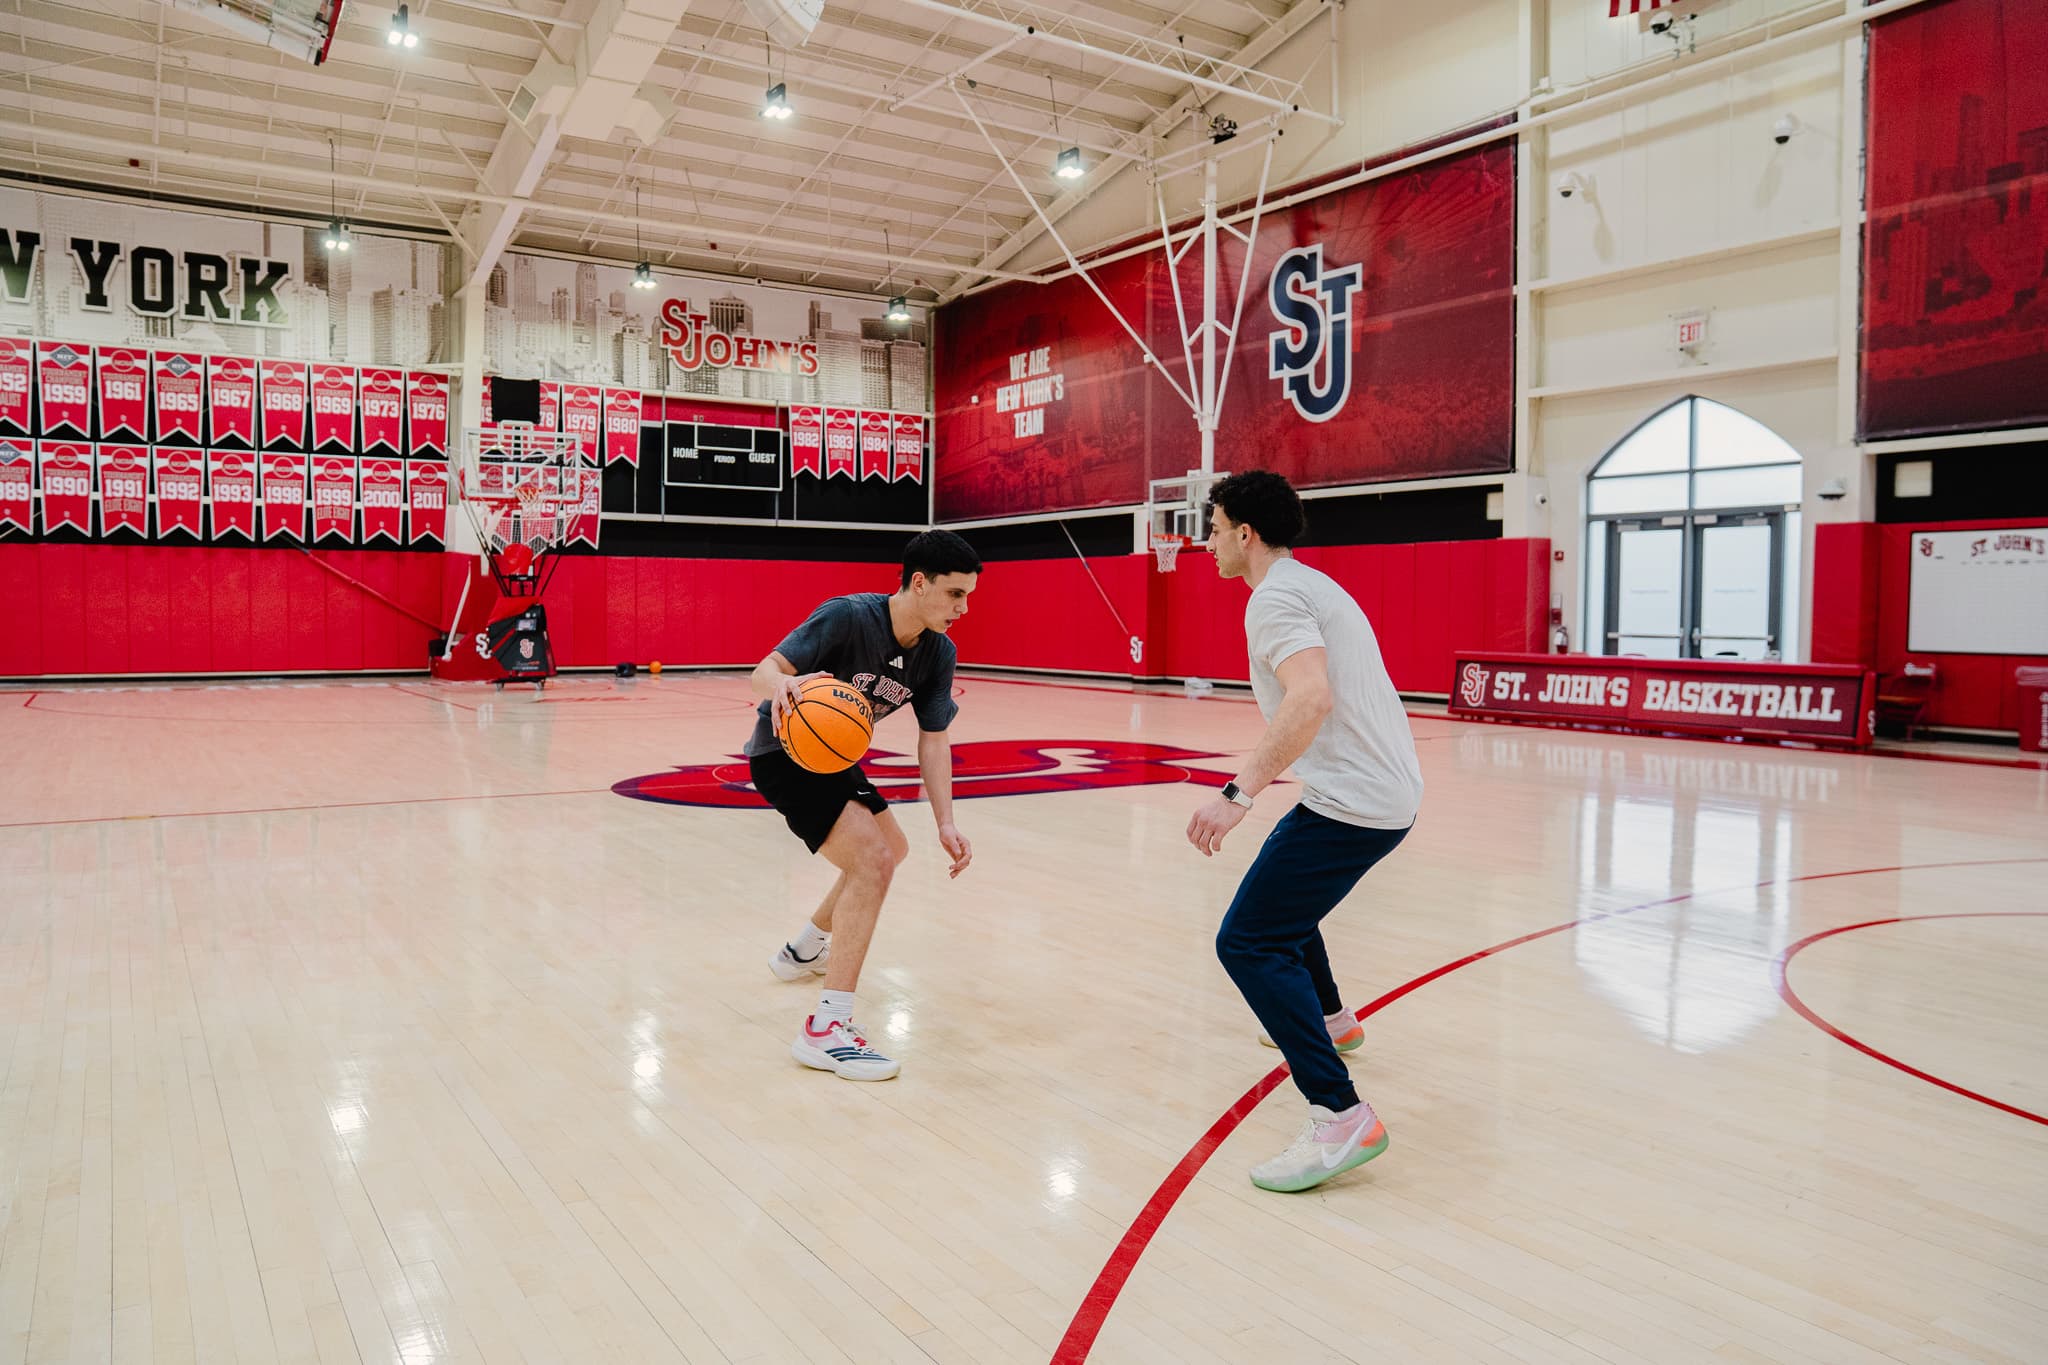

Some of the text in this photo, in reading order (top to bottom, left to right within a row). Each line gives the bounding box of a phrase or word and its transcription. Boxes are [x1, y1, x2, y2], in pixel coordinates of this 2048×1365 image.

[71, 237, 289, 324] YORK
[1010, 346, 1050, 380] WE ARE
[0, 373, 26, 392] 52
[105, 381, 142, 401] 1961
[44, 384, 86, 404] 1959
[159, 392, 198, 412] 1965
[213, 388, 251, 408] 1967
[266, 392, 302, 411] 1968
[997, 374, 1064, 413] NEW YORK'S
[316, 395, 351, 415] 1969
[365, 399, 399, 418] 1973
[412, 402, 445, 421] 1976
[539, 411, 555, 428] 78
[567, 413, 596, 431] 1979
[608, 416, 637, 434] 1980
[1014, 408, 1044, 439] TEAM
[793, 431, 819, 448] 1982
[829, 434, 853, 450] 1983
[863, 437, 888, 452] 1984
[896, 440, 920, 454] 1985
[673, 447, 699, 459] HOME
[749, 453, 776, 464] GUEST
[45, 476, 88, 496] 1990
[105, 479, 143, 498] 1991
[160, 481, 200, 501] 1992
[214, 483, 252, 502] 1993
[266, 486, 302, 505] 1998
[316, 487, 351, 507] 1999
[364, 490, 400, 508] 2000
[413, 492, 444, 510] 2011
[873, 675, 914, 705] JOHN'
[1493, 672, 1530, 701] ST.
[1538, 674, 1630, 707] JOHN'S
[1643, 679, 1842, 722] BASKETBALL
